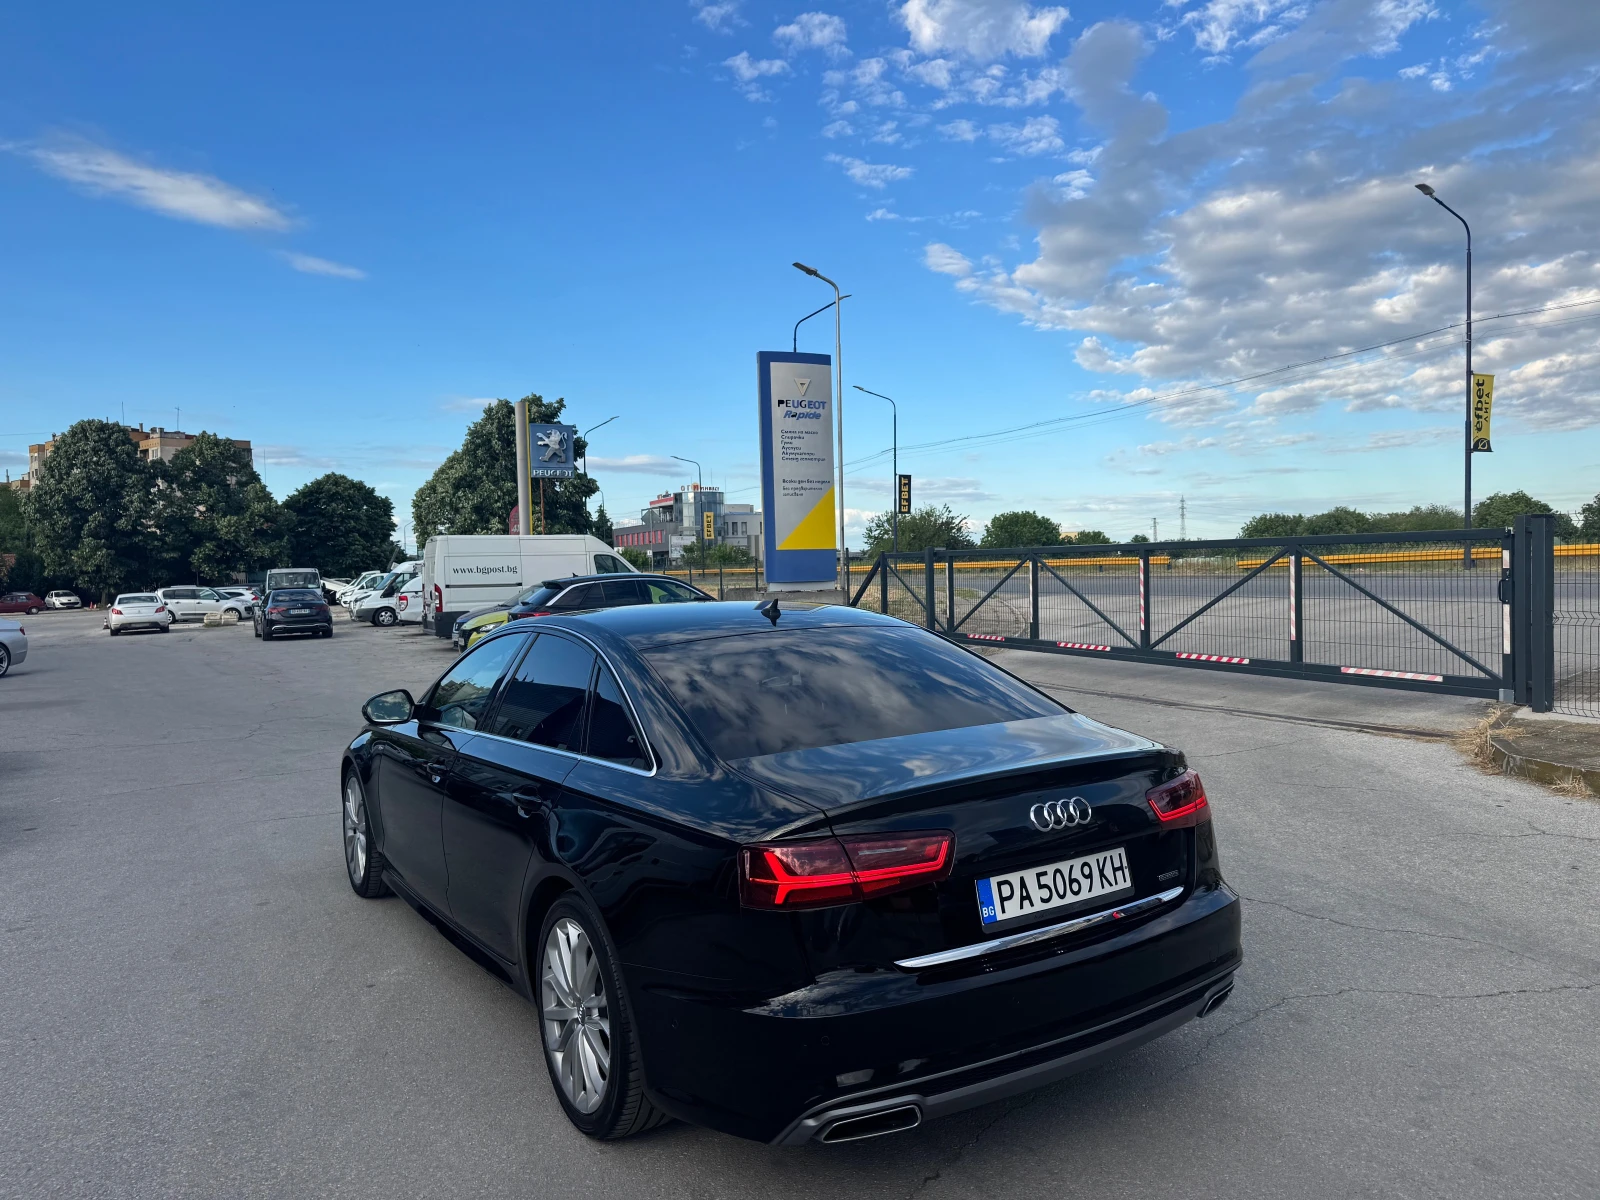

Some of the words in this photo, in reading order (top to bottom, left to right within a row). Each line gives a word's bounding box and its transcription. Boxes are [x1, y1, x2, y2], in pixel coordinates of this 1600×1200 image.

[778, 400, 826, 410] PEUGEOT
[1474, 378, 1484, 432] efbet
[783, 410, 822, 420] Rapide
[452, 565, 518, 575] www.bgpost.bg
[982, 906, 994, 918] BG
